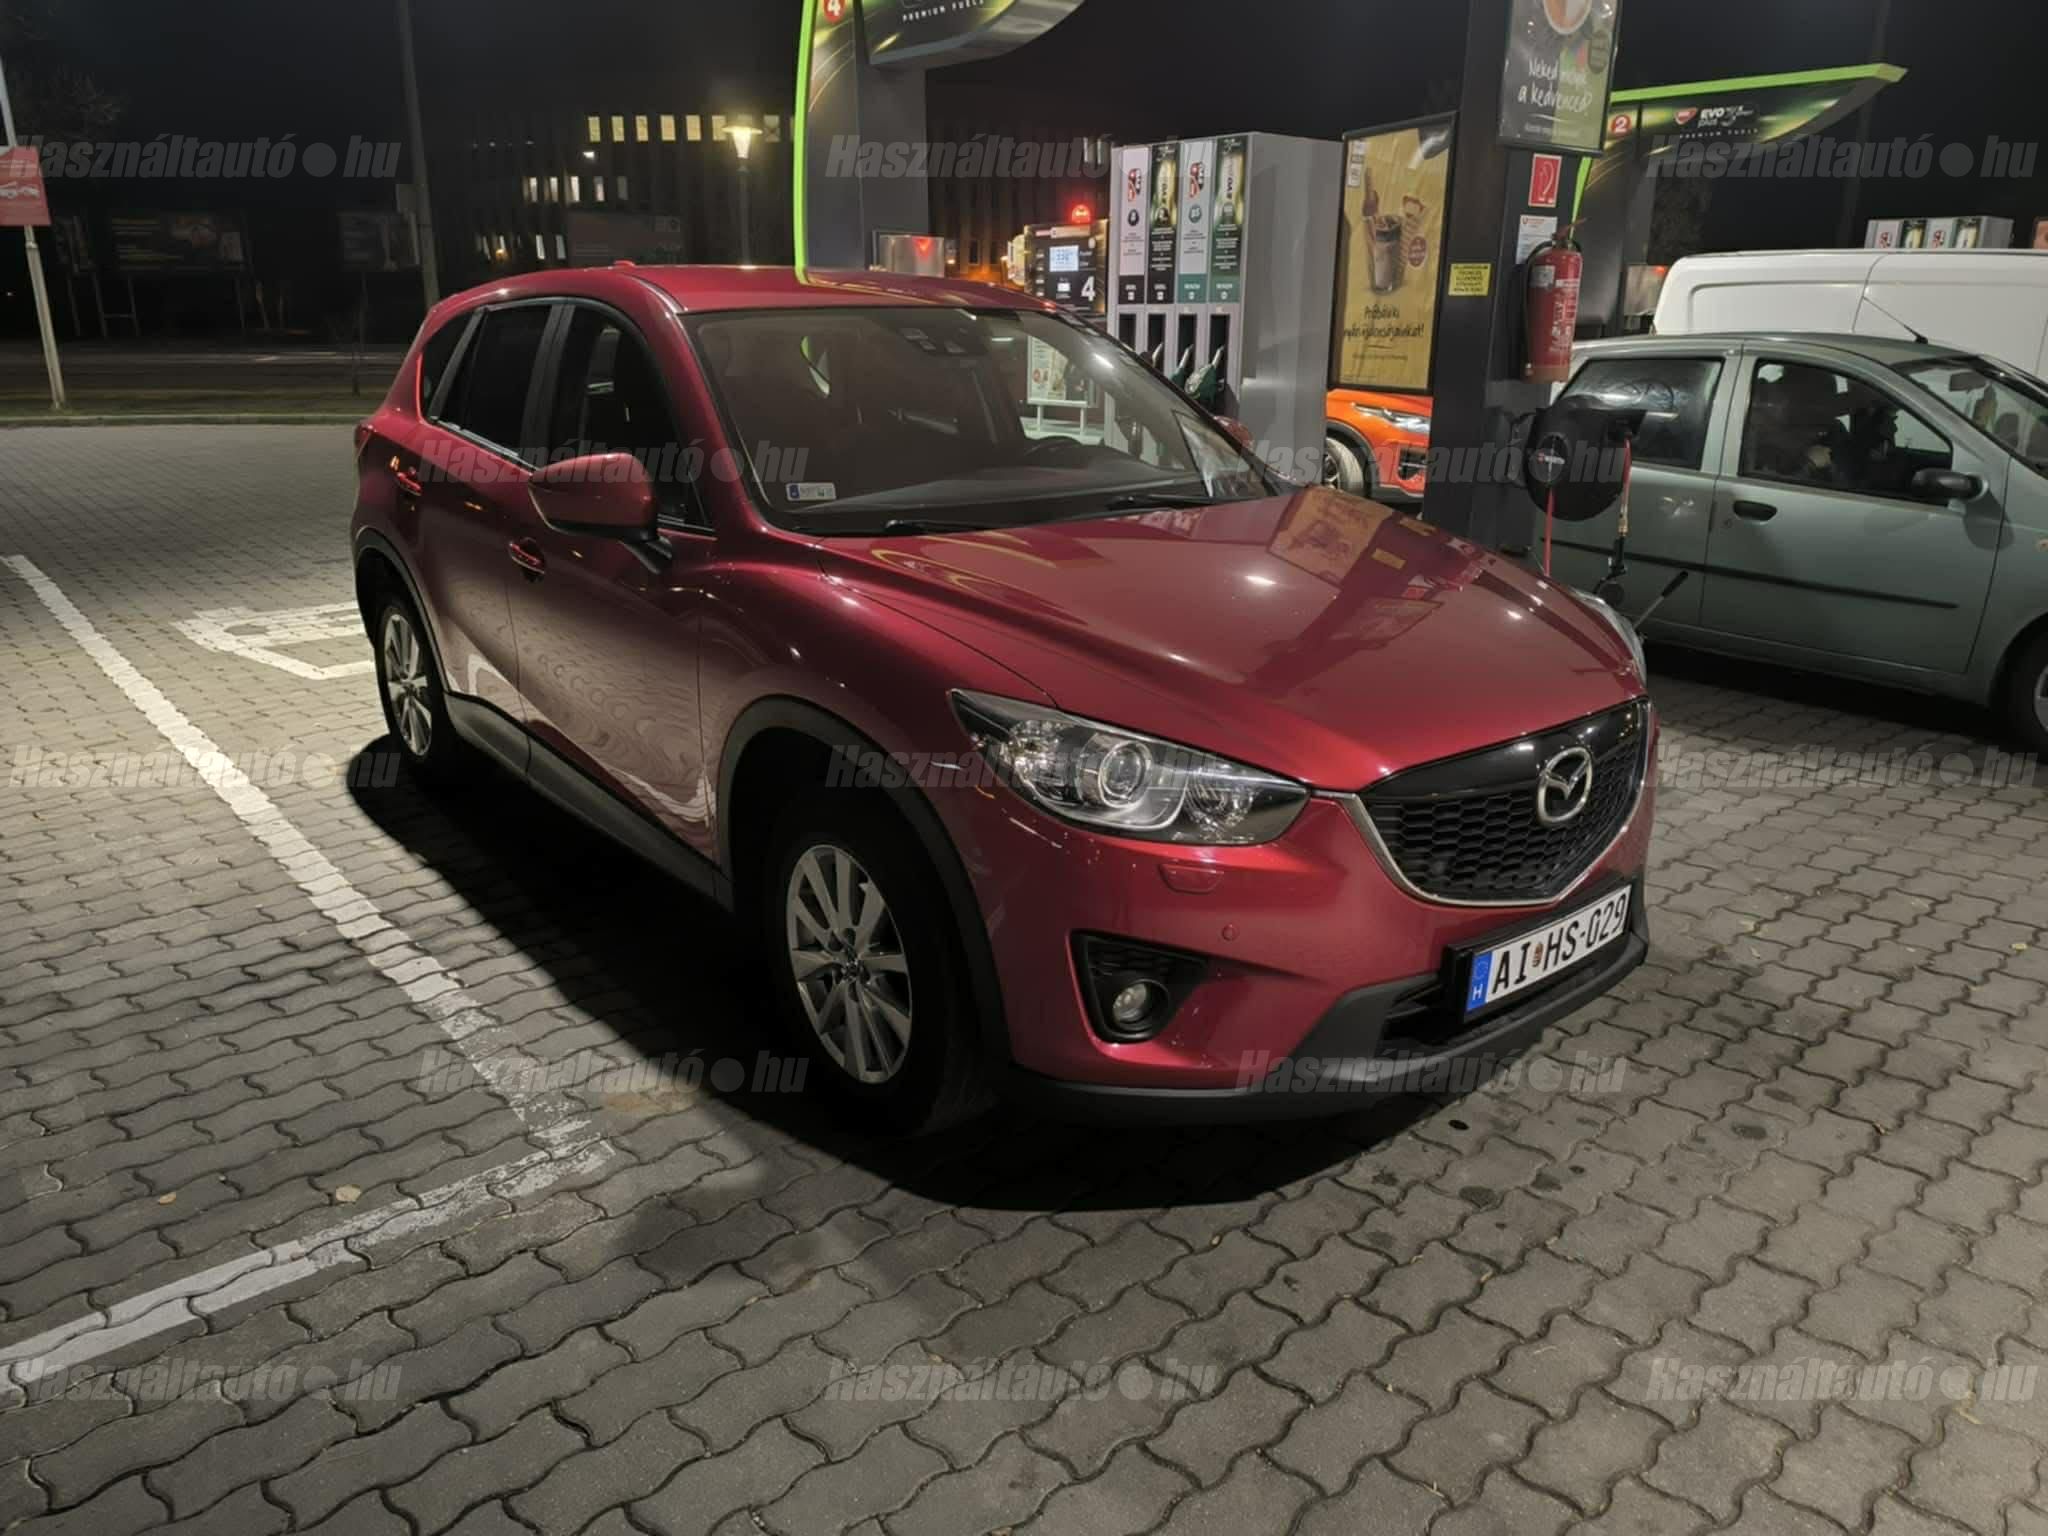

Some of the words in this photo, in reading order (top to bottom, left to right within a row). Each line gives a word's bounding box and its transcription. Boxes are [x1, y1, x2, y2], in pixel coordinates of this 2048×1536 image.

[1700, 107, 1726, 120] EVO
[1615, 116, 1628, 134] 2
[1080, 275, 1096, 302] 4
[1492, 941, 1531, 995] AI
[1543, 892, 1627, 971] HS-029
[1472, 983, 1483, 1000] H
